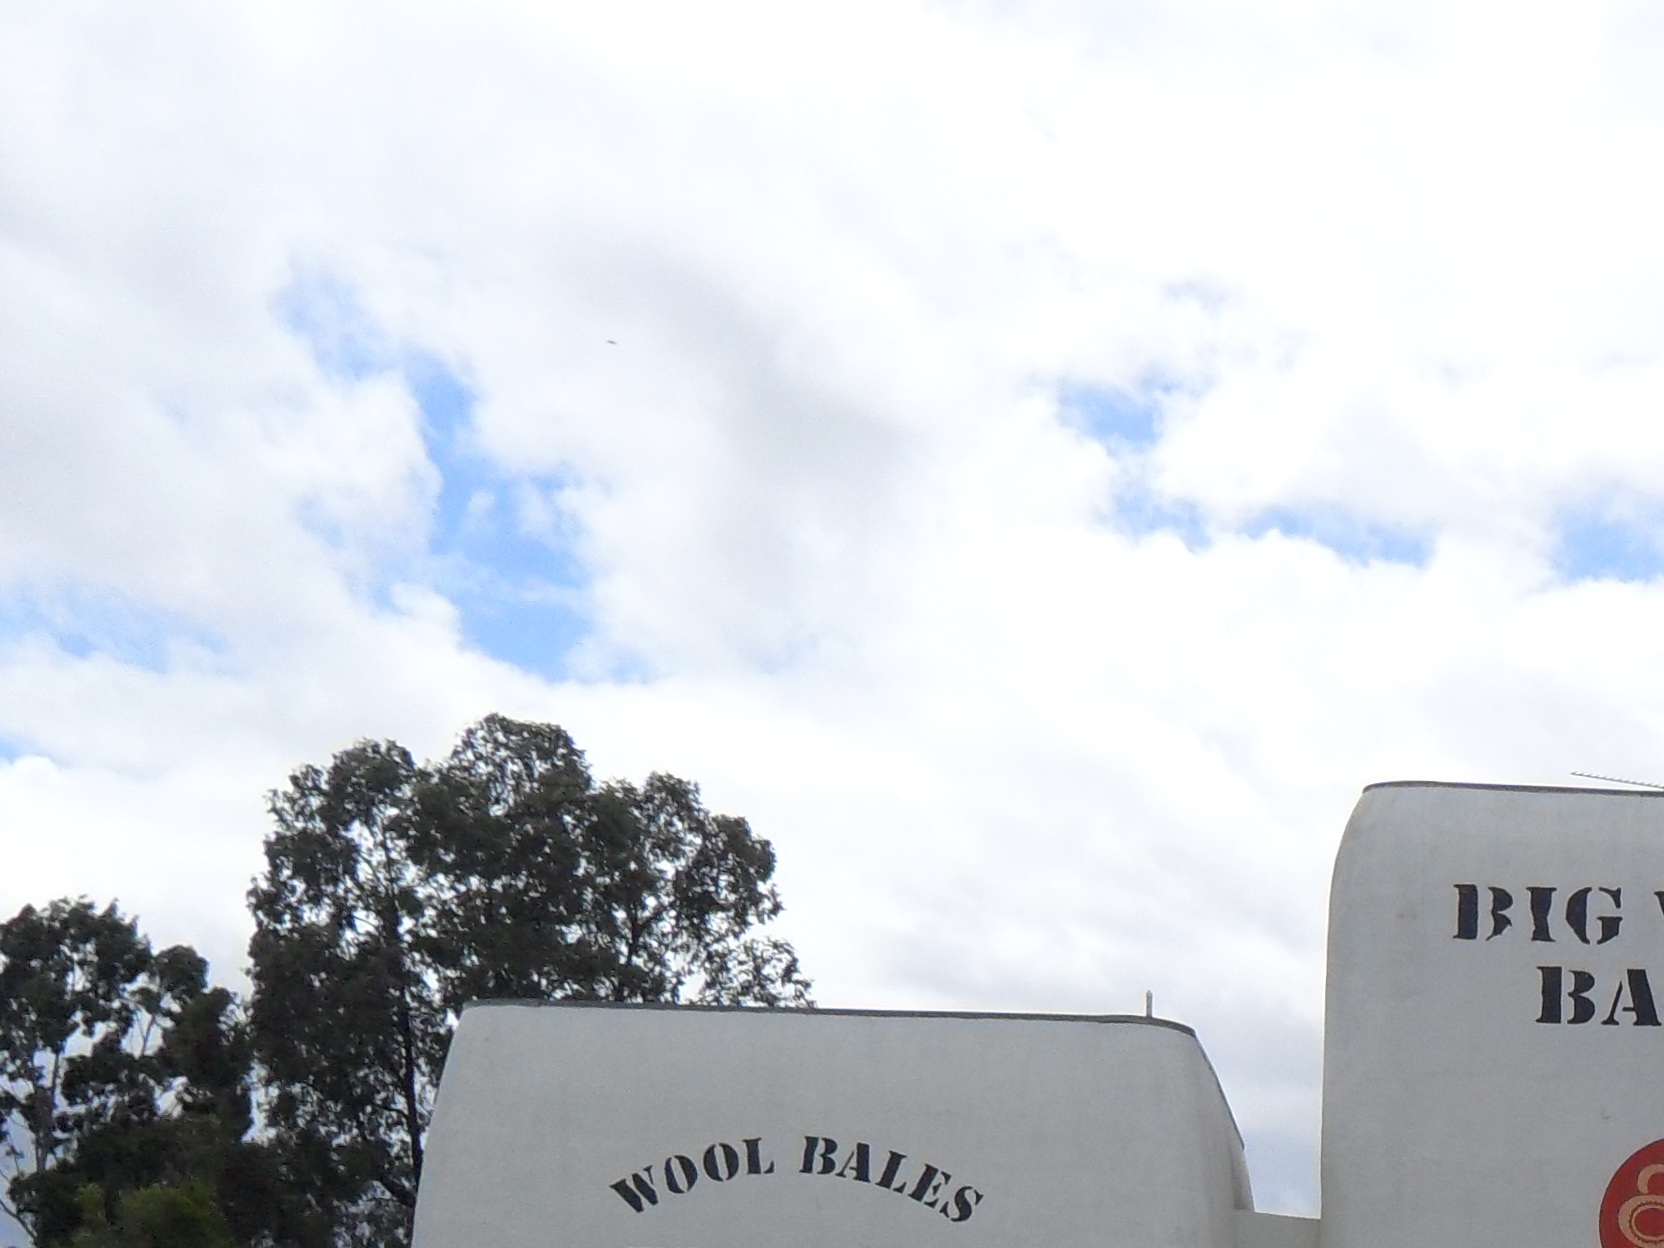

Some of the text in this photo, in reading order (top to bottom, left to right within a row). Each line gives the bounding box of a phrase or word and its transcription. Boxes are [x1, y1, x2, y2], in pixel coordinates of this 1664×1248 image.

[1452, 883, 1624, 946] BIG
[609, 1135, 985, 1223] WOOL BALES
